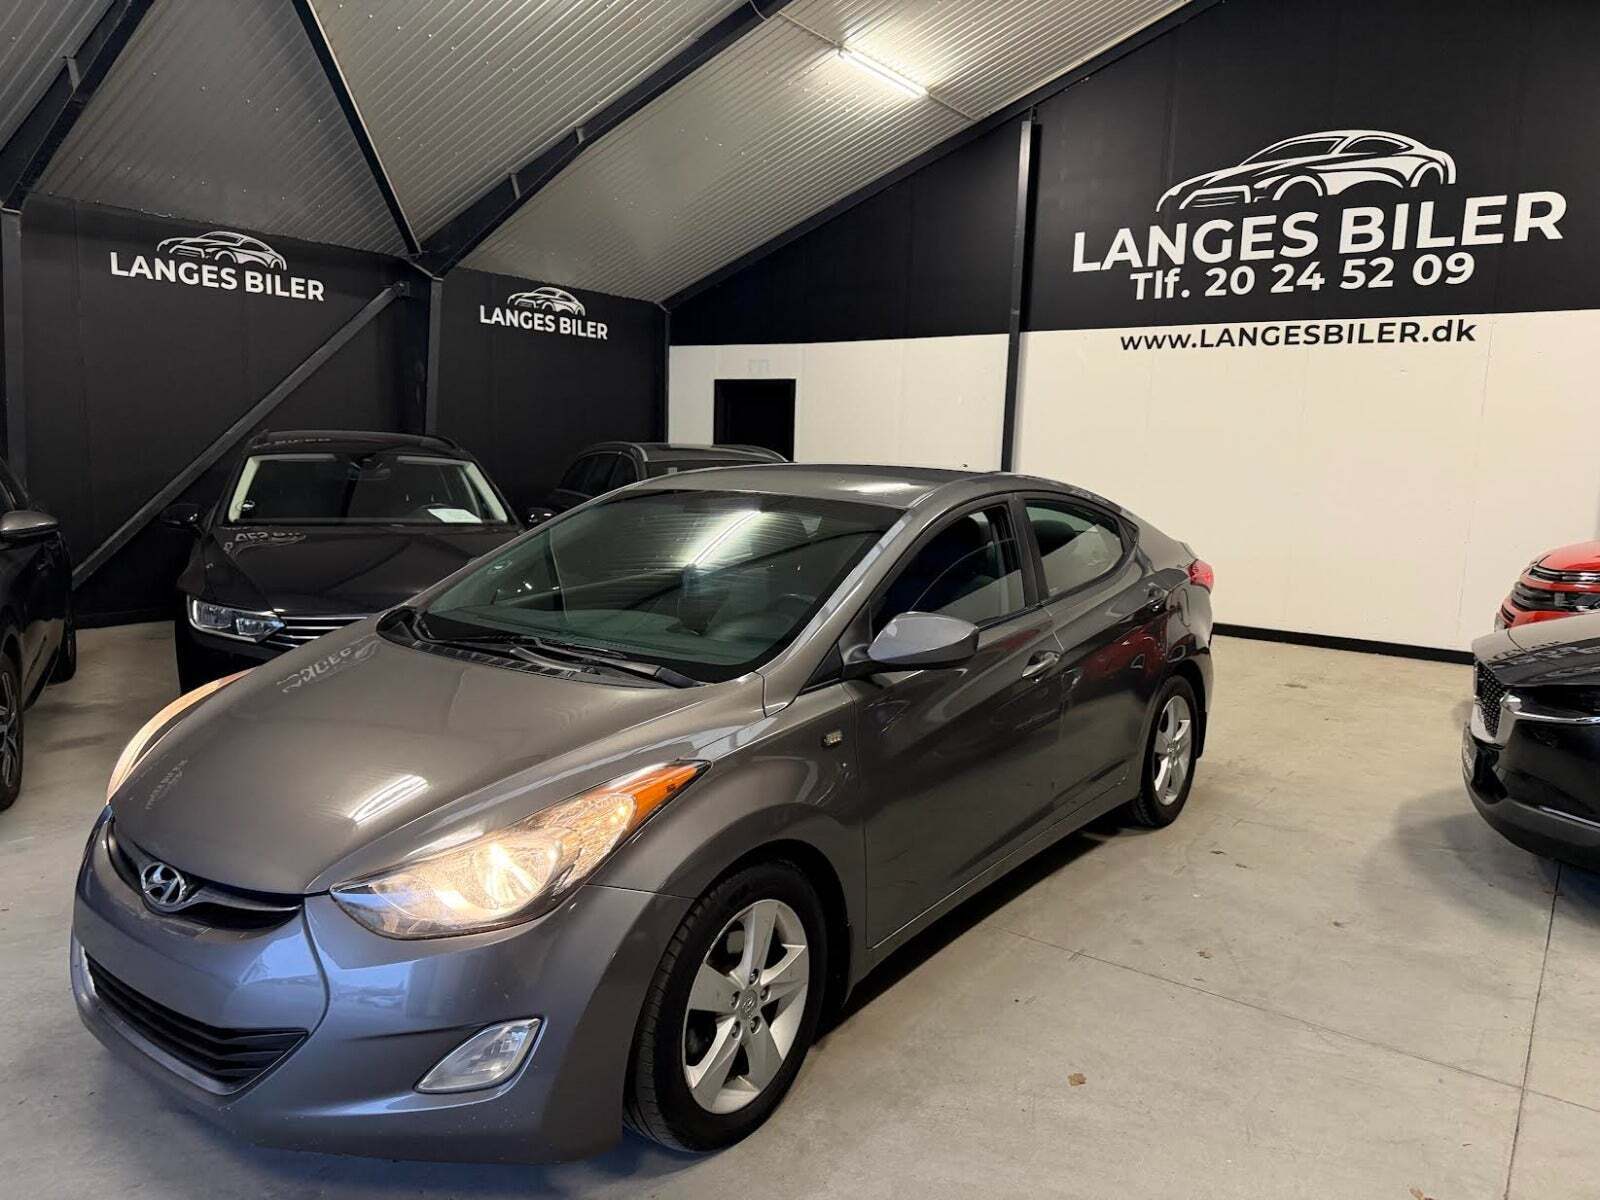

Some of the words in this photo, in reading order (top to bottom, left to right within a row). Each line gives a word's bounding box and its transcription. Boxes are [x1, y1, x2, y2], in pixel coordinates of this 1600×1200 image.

[1072, 211, 1319, 273] LANGES
[1338, 190, 1567, 254] BILER
[110, 251, 238, 291] LANGES
[244, 270, 325, 302] BILER
[1129, 267, 1191, 301] Tlf.
[1204, 265, 1256, 297] 20
[1270, 261, 1326, 294] 24
[1339, 256, 1395, 290] 52
[1412, 251, 1475, 286] 09
[479, 304, 556, 333] LANGES
[559, 316, 608, 340] BILER
[1120, 318, 1477, 351] www.LANGESBILER.dk
